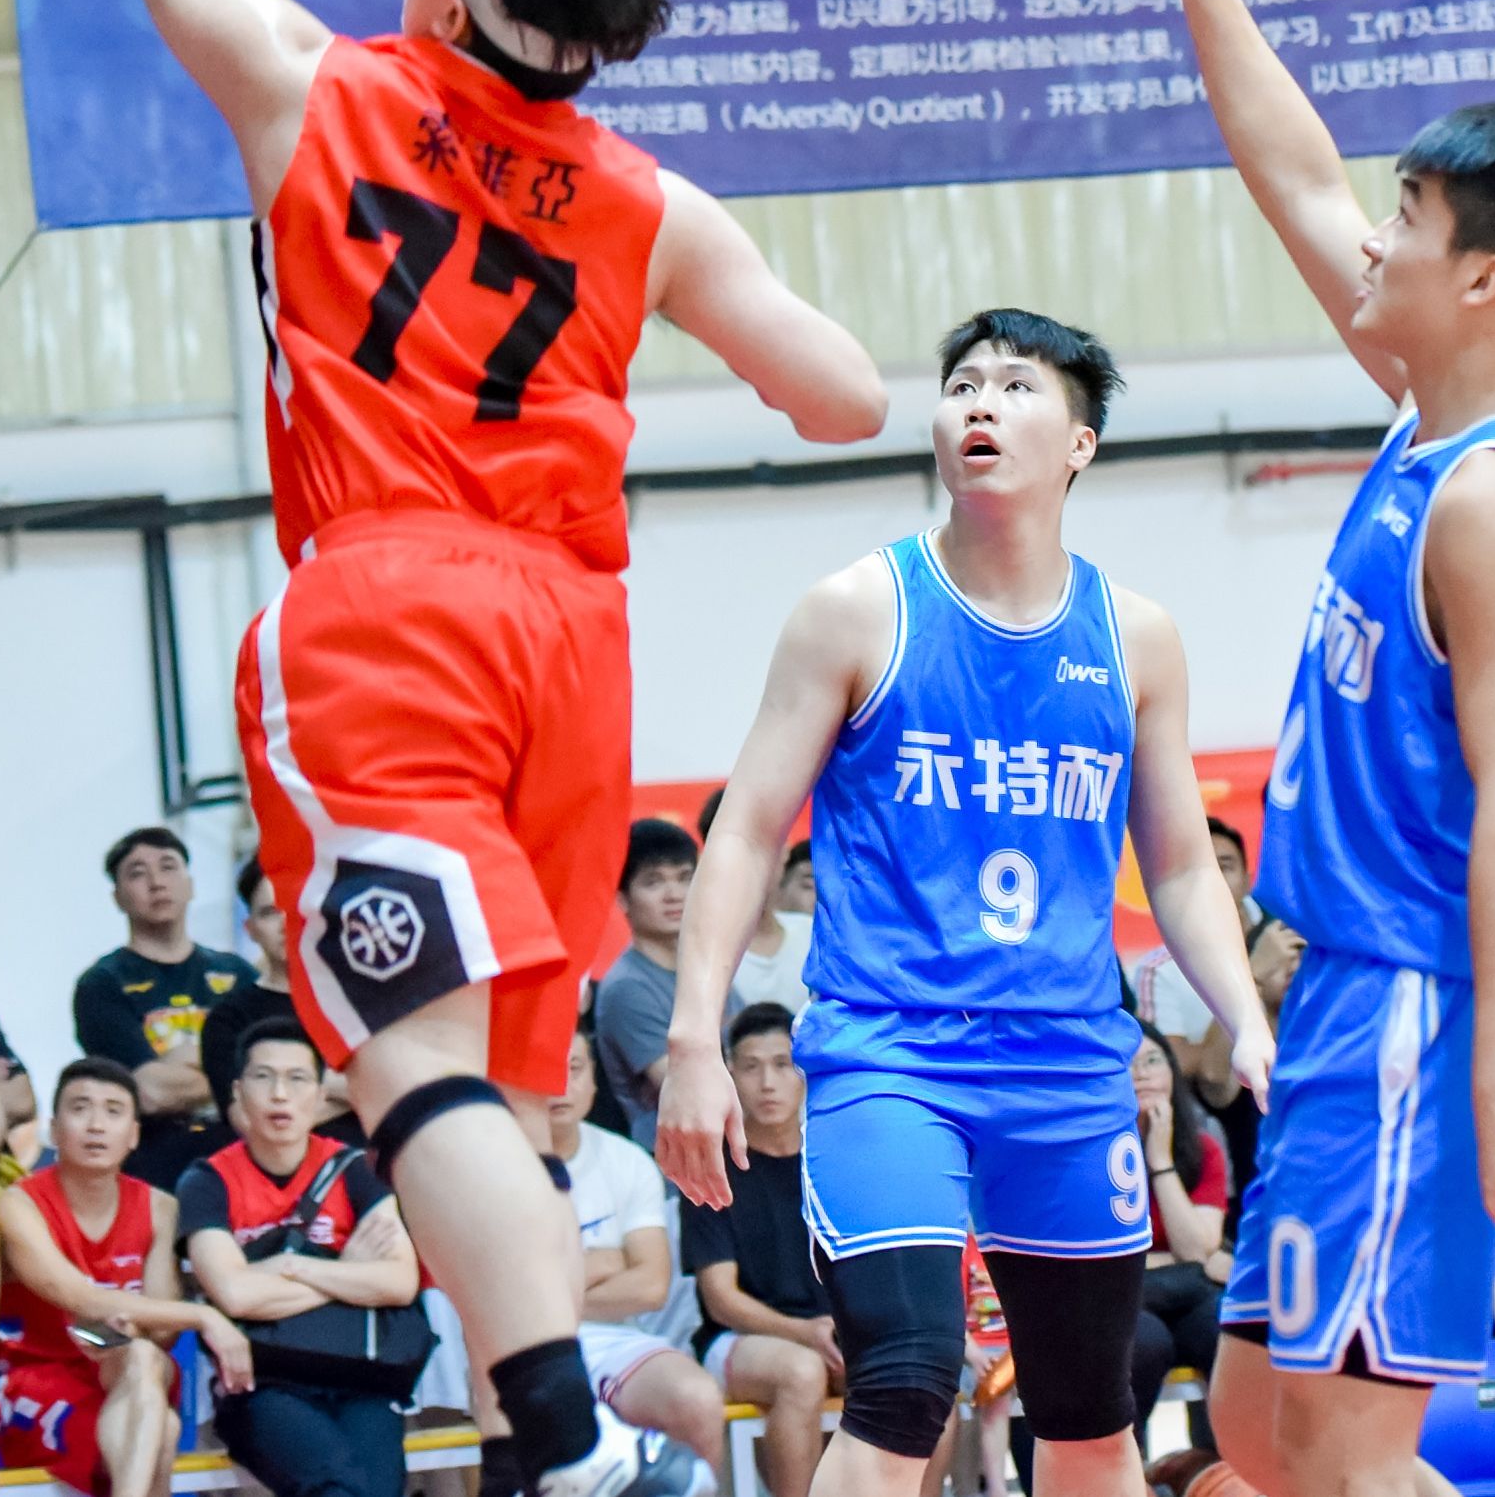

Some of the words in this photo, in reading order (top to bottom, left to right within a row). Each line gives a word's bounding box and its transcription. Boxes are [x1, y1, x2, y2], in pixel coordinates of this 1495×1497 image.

[345, 176, 578, 422] 77
[892, 729, 1124, 823] 永特耐
[978, 847, 1040, 946] 9
[1106, 1130, 1150, 1226] 9
